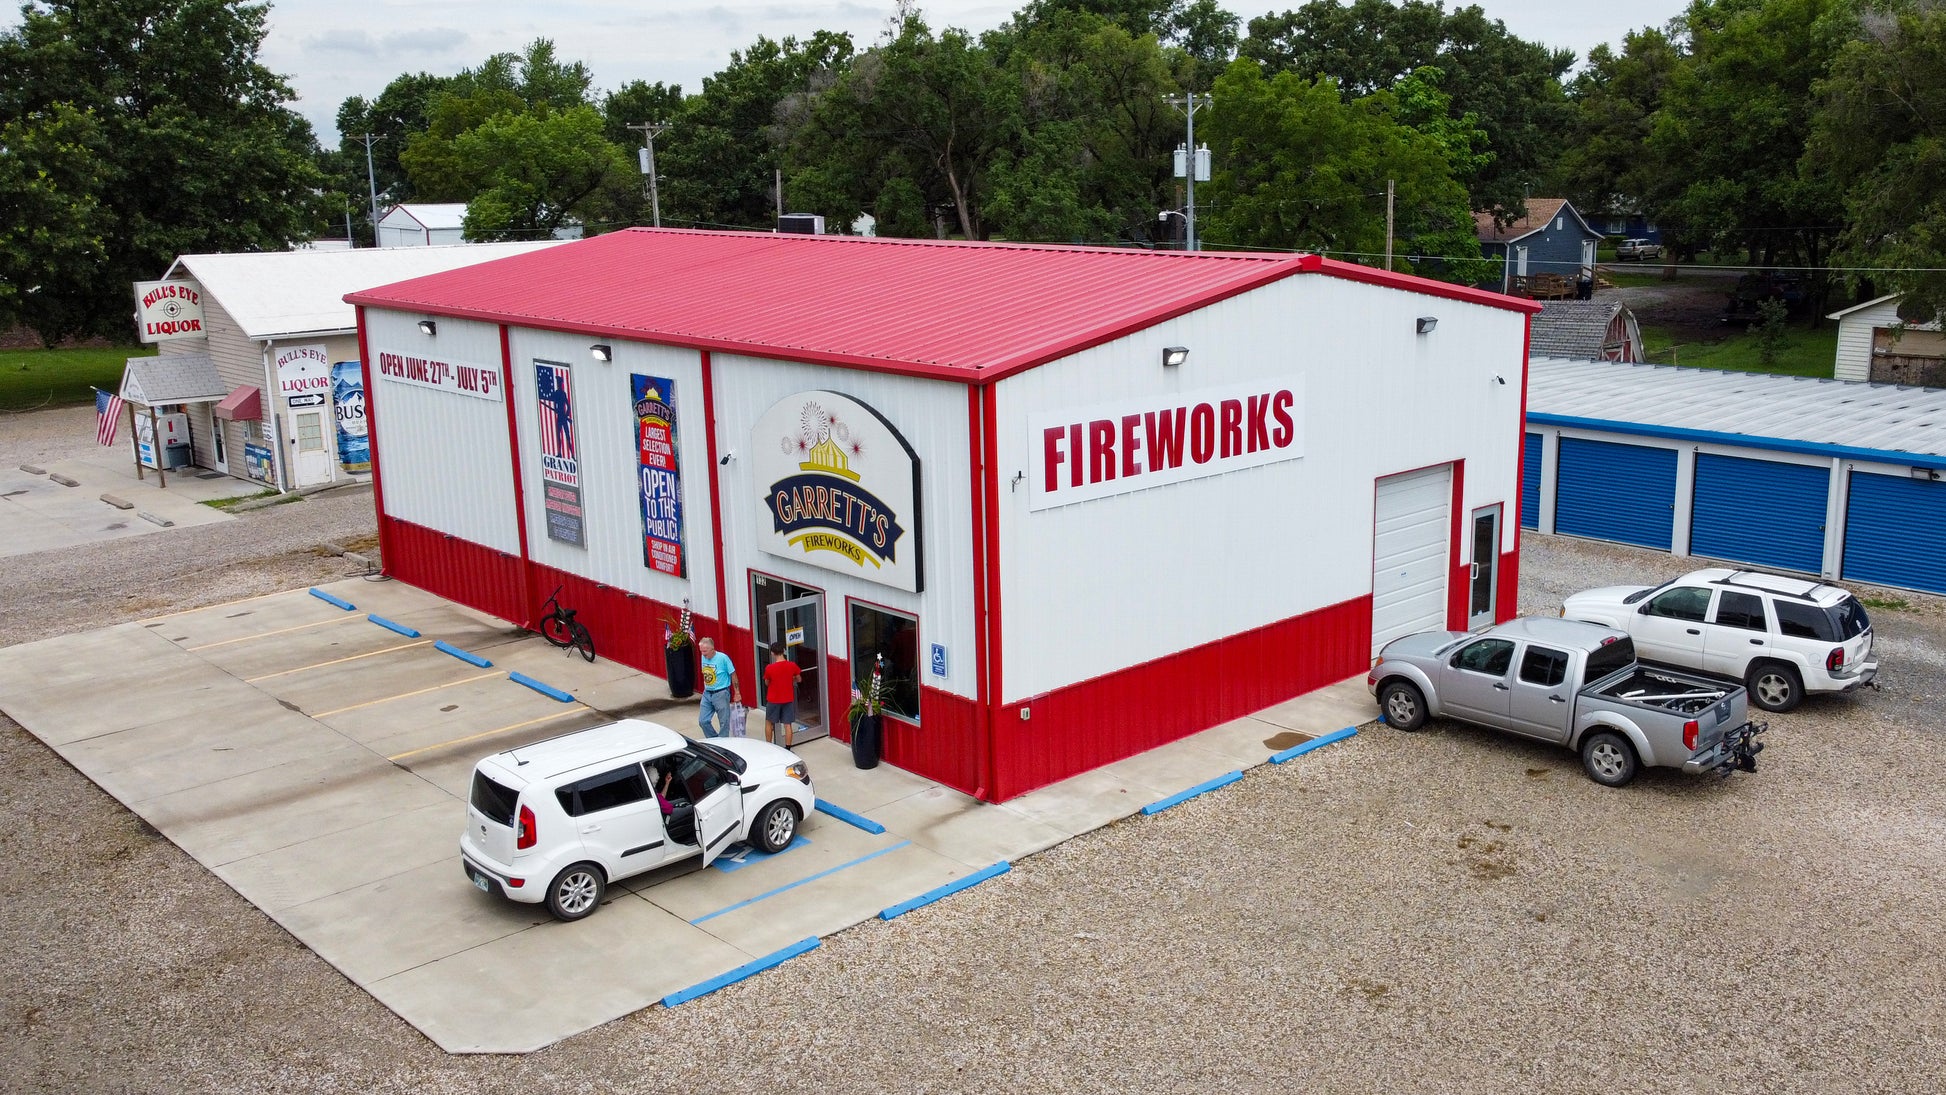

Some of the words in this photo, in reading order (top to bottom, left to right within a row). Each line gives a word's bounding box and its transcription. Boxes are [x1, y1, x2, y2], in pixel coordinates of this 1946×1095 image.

[142, 285, 177, 309] BULL'S
[178, 286, 199, 305] EYE
[147, 319, 202, 335] LIQUOR
[278, 348, 308, 368] BULL'S
[309, 349, 327, 365] EYE
[282, 376, 329, 392] LIQUOR
[380, 352, 405, 378] OPEN
[406, 356, 430, 382] JUNE
[430, 360, 450, 385] 27TH
[457, 365, 479, 392] JULY
[481, 369, 498, 394] 5TH
[645, 426, 666, 442] LARGEST
[1044, 389, 1294, 493] FIREWORKS
[643, 439, 672, 455] SELECTION
[544, 456, 577, 474] GRAND
[649, 453, 667, 468] EVER!
[545, 468, 577, 485] PATRIOT
[643, 467, 676, 500] OPEN
[644, 496, 657, 519] TO
[658, 497, 677, 522] THE
[776, 485, 889, 549] GARRETT'S
[647, 517, 679, 541] PUBLIC!
[805, 534, 861, 561] FIREWORKS
